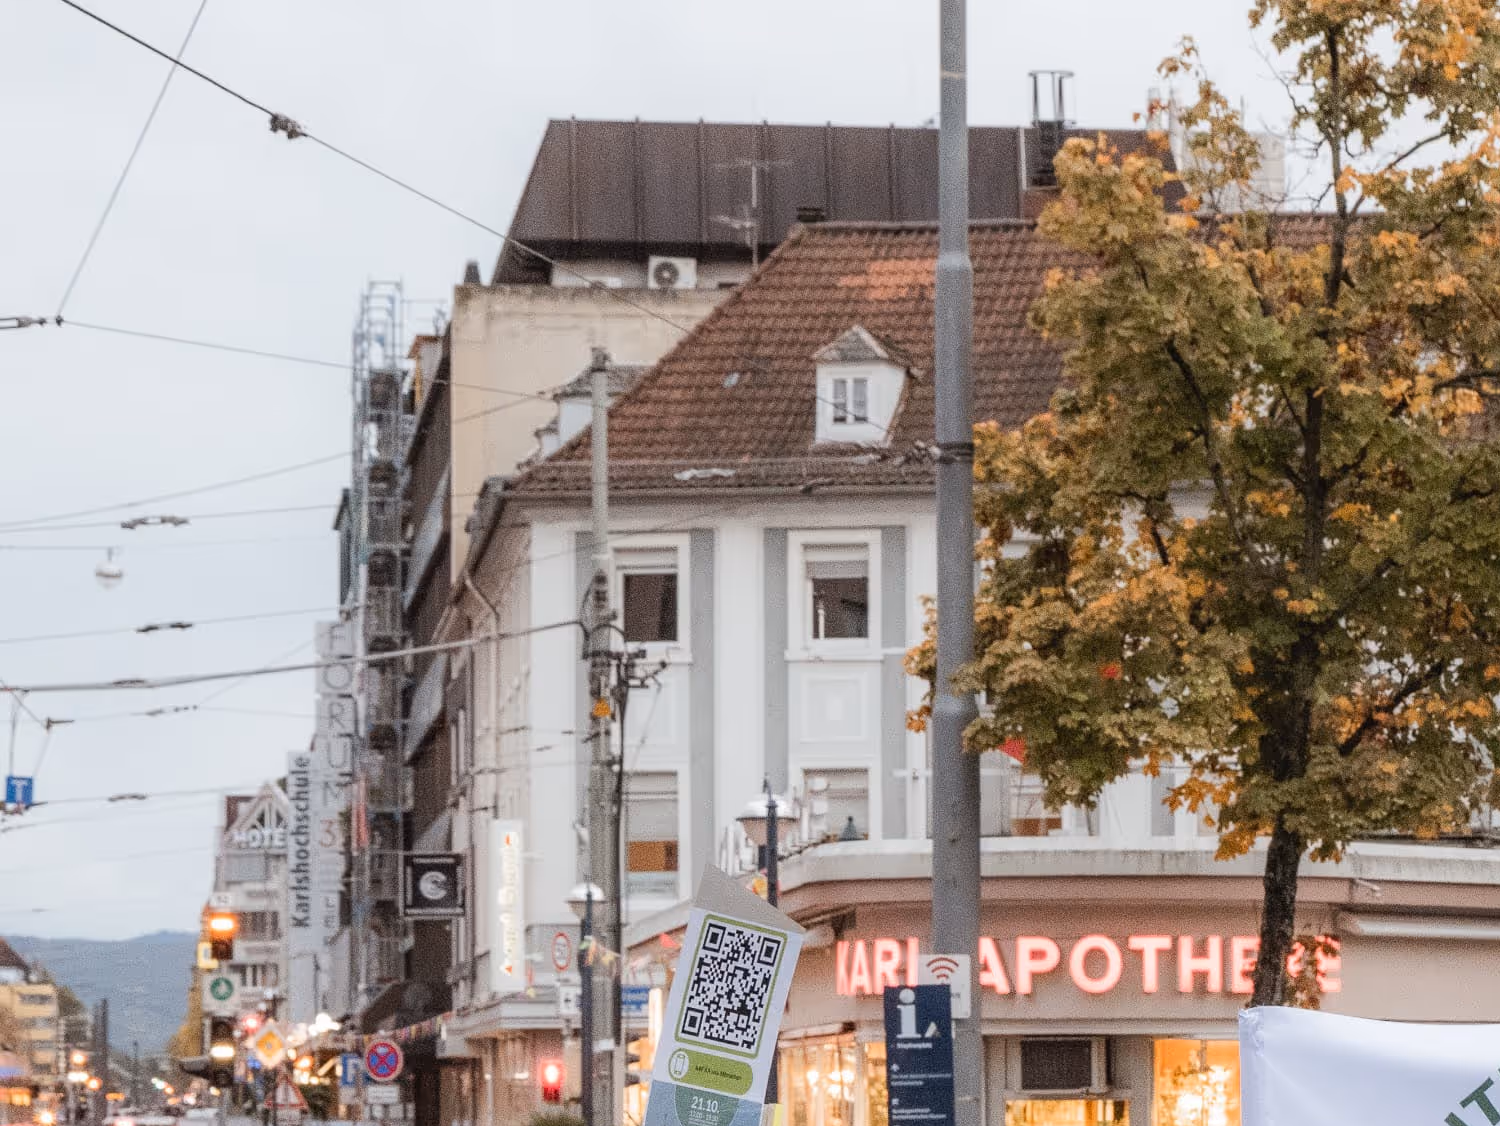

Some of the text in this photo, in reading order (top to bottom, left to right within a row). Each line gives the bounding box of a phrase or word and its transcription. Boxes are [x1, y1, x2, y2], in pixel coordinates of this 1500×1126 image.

[290, 756, 311, 928] Karlshochschule
[978, 933, 1342, 996] APOTHEE
[691, 1096, 720, 1113] 21.10.
